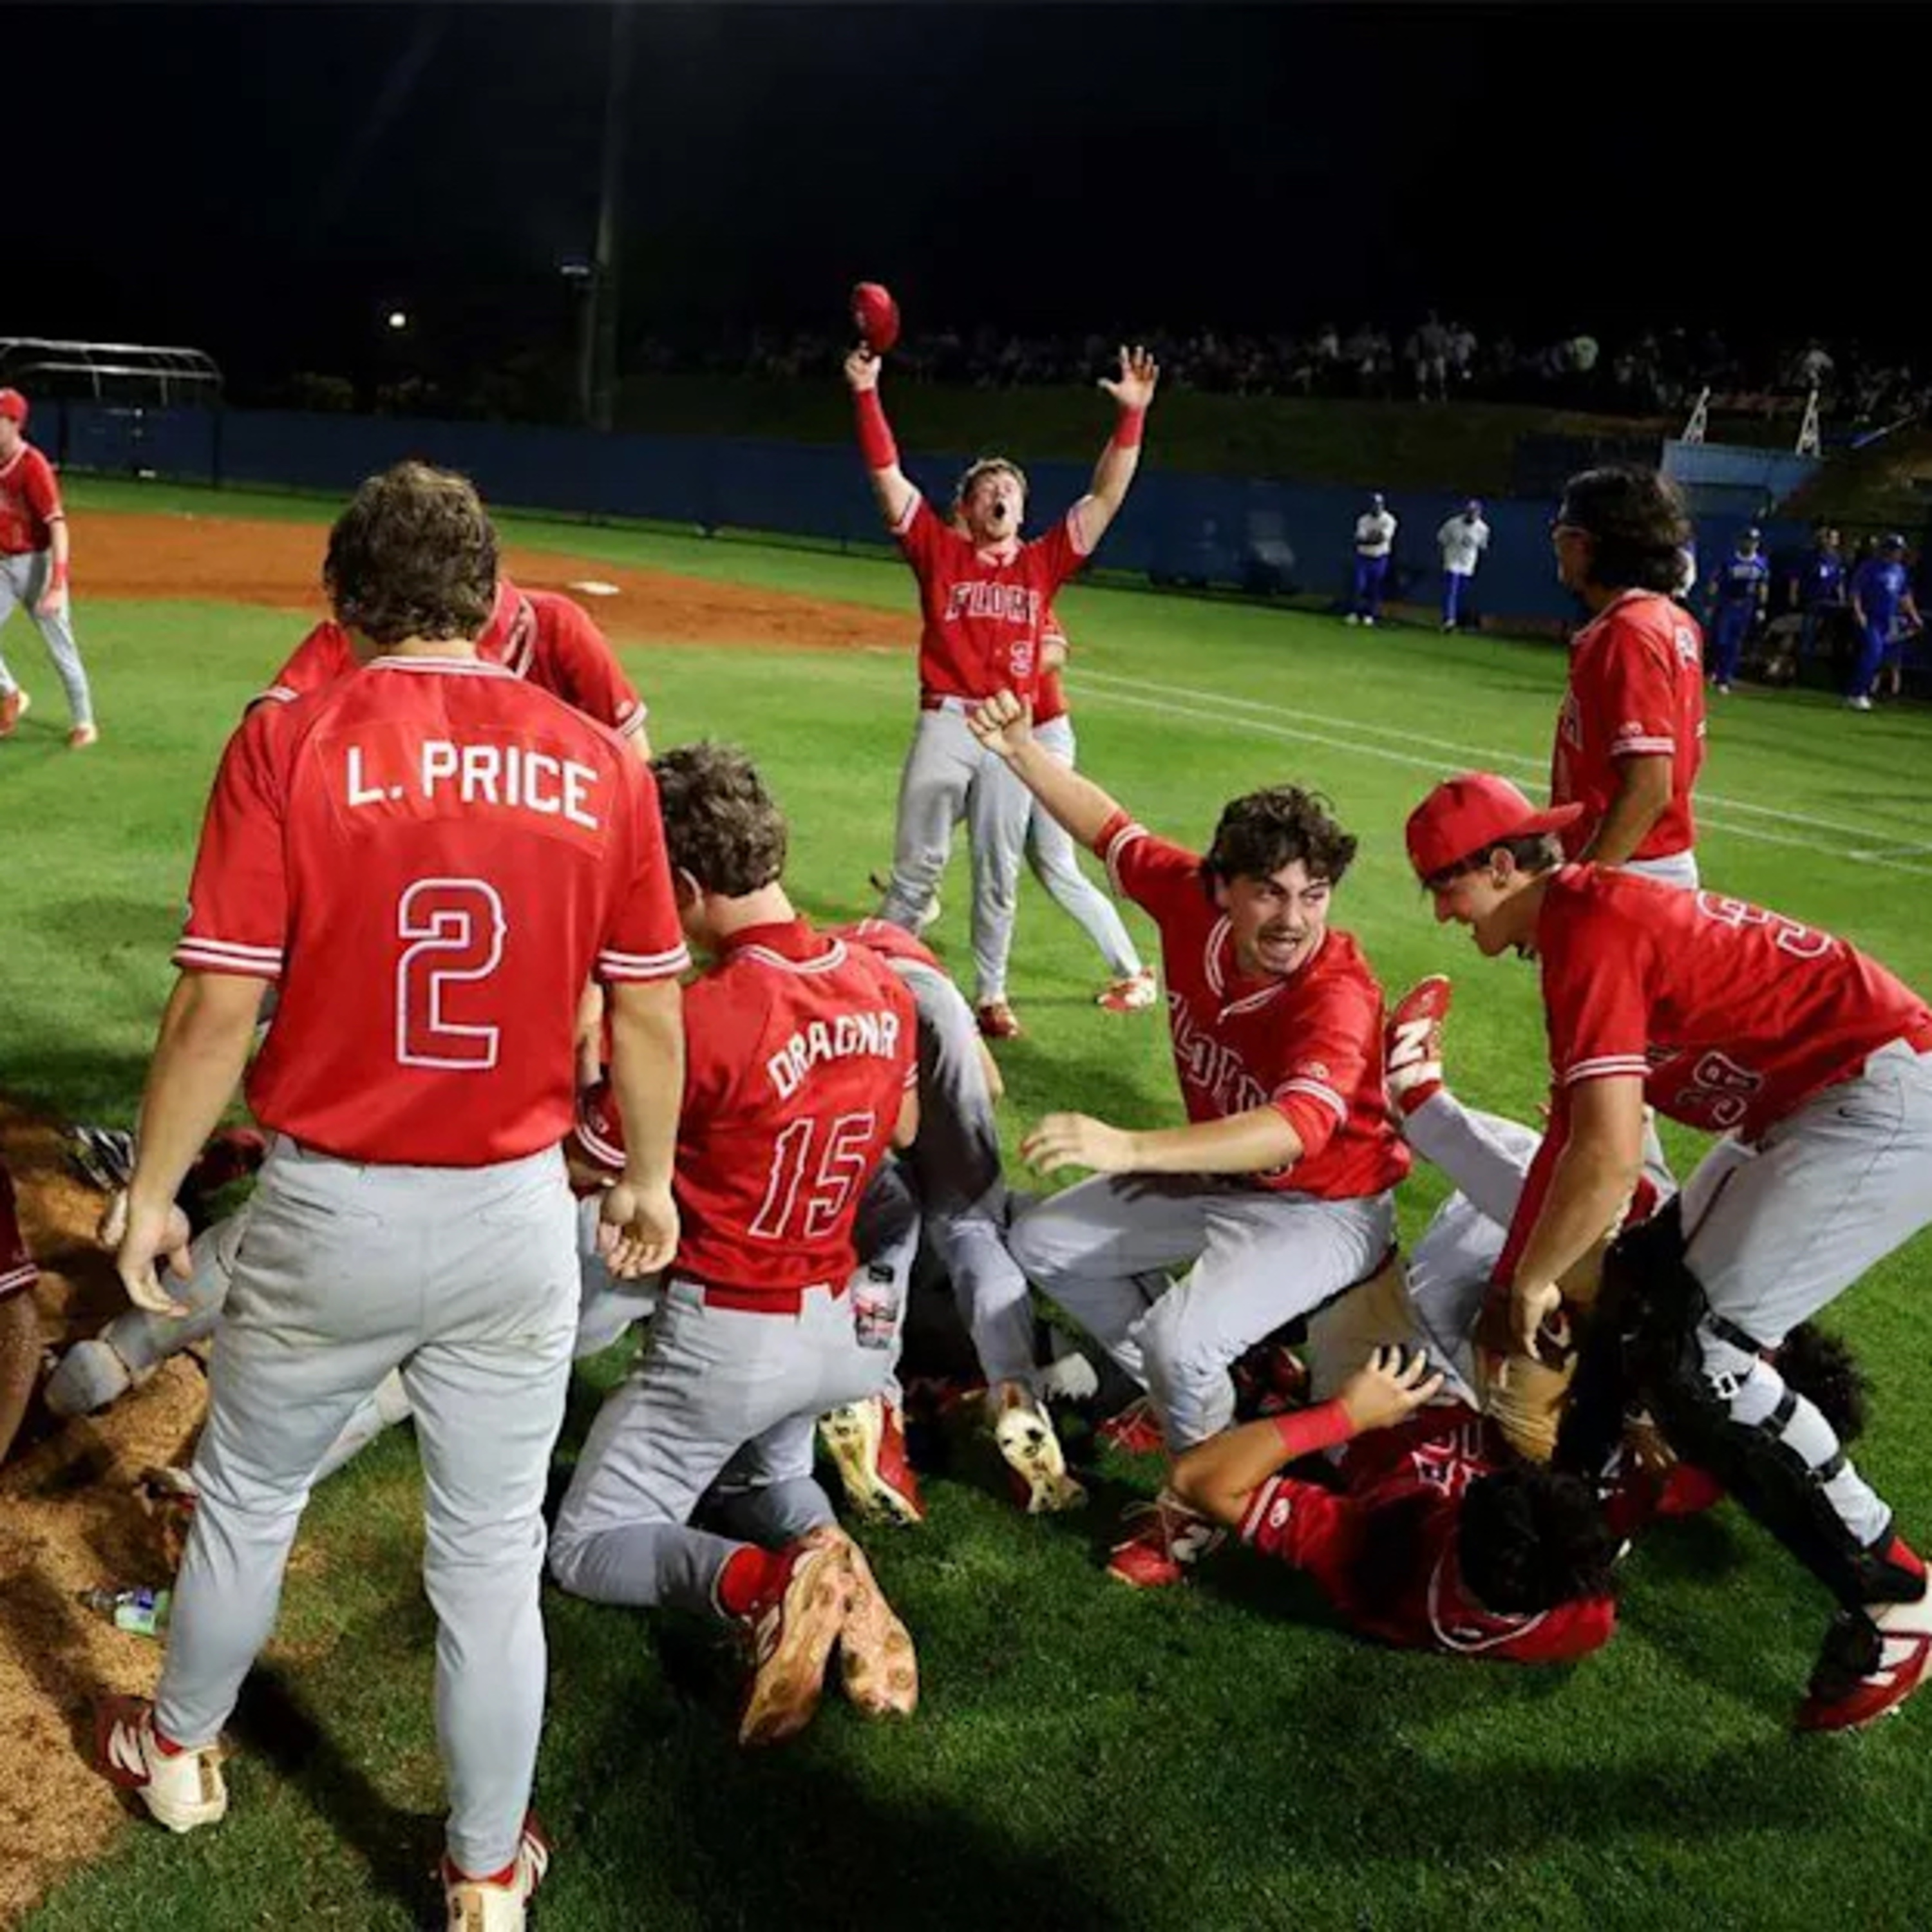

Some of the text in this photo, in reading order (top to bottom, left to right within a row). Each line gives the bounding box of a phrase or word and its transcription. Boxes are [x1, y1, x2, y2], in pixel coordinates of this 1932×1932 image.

[348, 741, 598, 830] L. PRICE
[397, 878, 507, 1070] 2
[748, 1112, 876, 1239] 15
